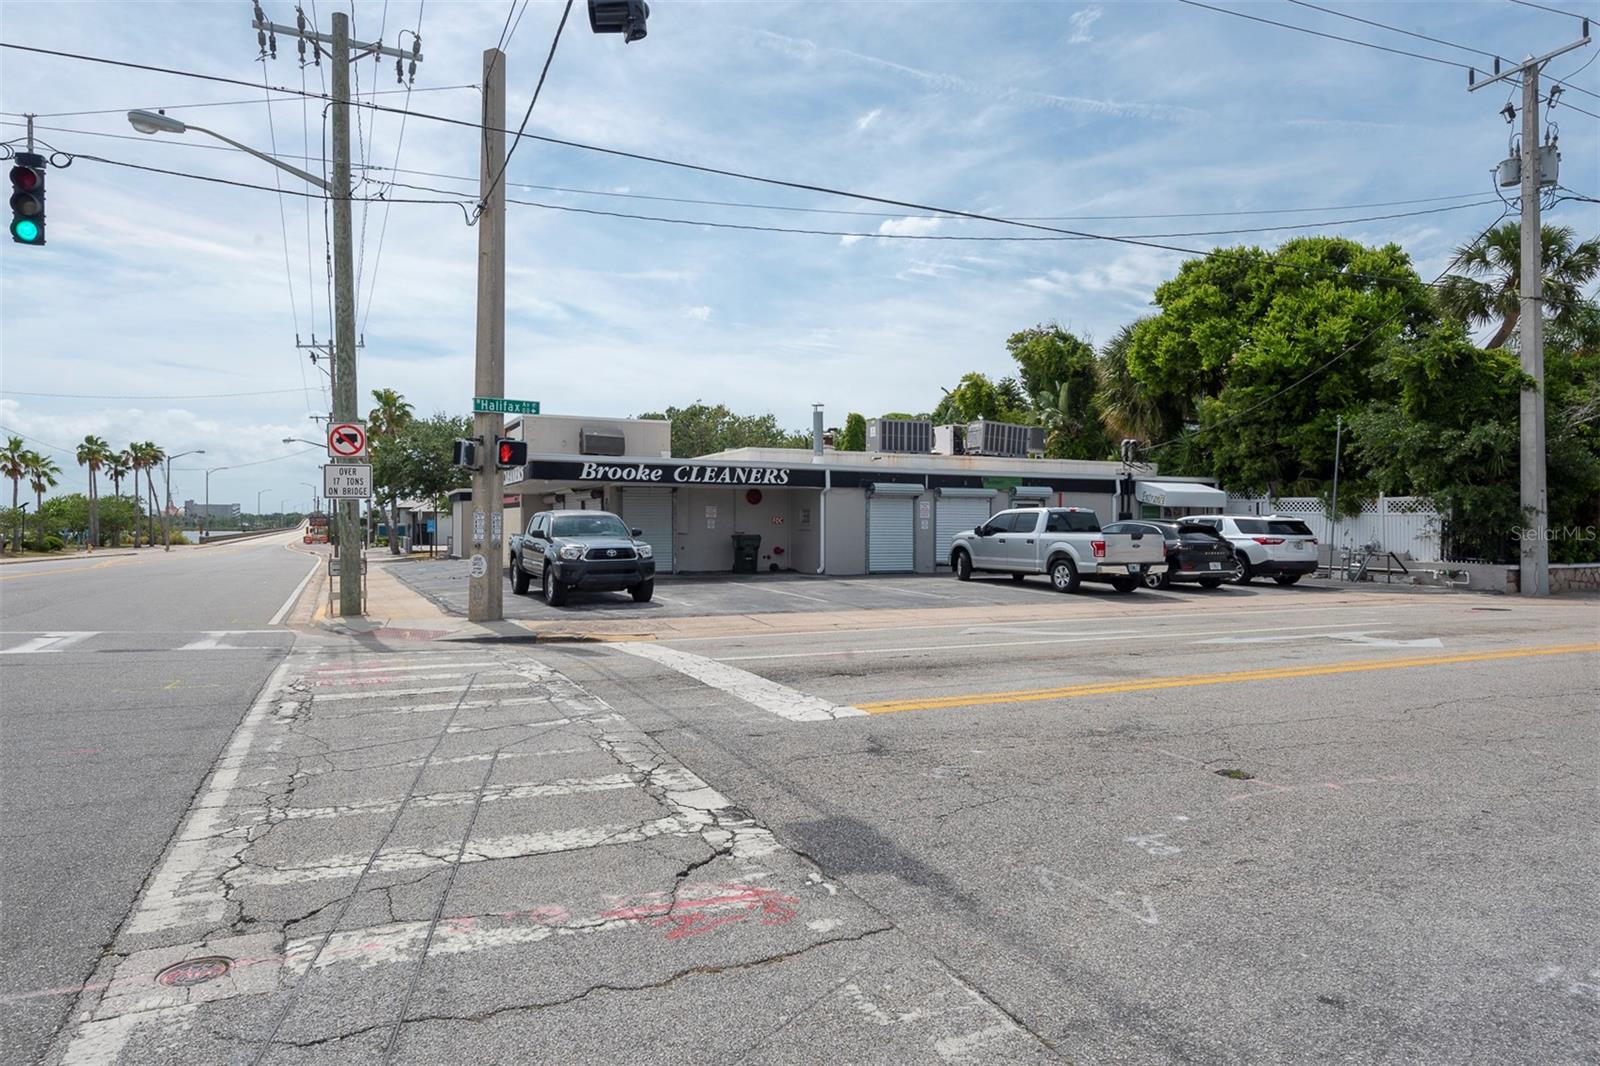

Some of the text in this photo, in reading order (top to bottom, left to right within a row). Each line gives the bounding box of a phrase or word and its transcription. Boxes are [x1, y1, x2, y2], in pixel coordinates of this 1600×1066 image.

[481, 400, 521, 412] Halifax
[339, 467, 357, 476] OVER
[579, 462, 790, 485] Brooke CLEANERS
[333, 477, 365, 487] 17 TONS
[328, 487, 368, 497] ON BRIDGE
